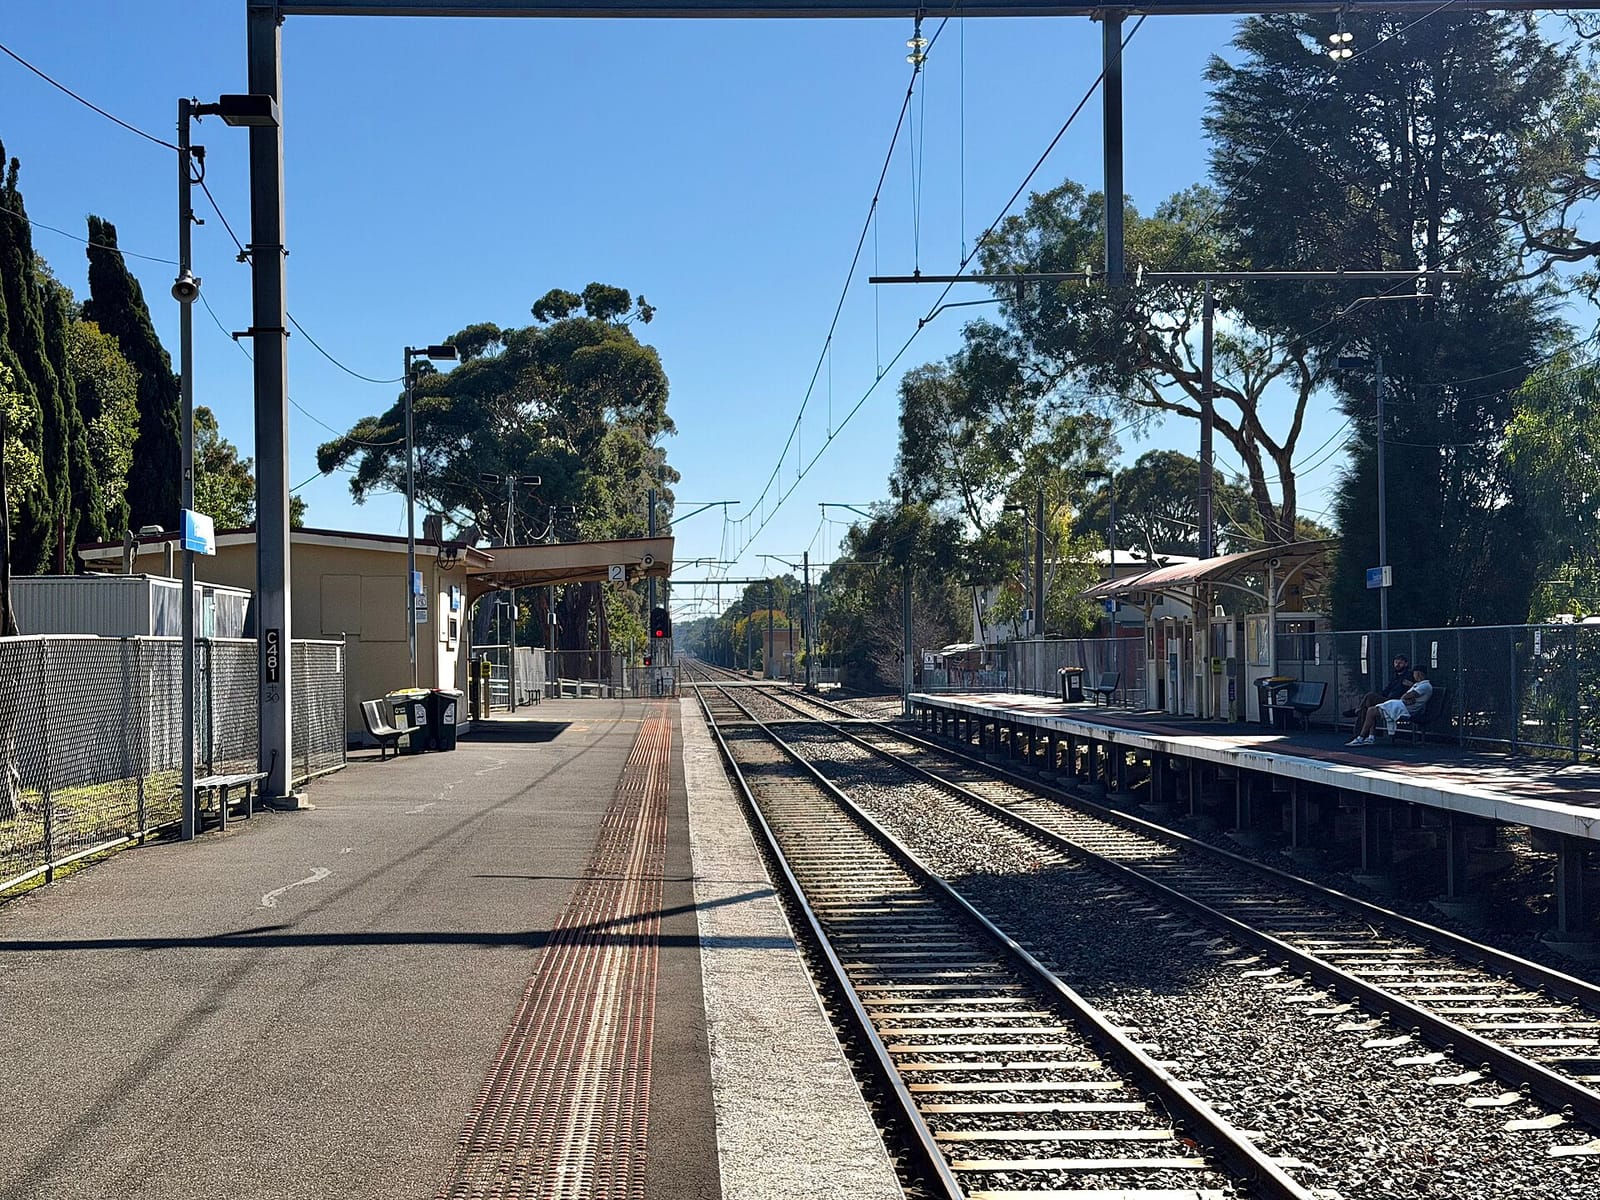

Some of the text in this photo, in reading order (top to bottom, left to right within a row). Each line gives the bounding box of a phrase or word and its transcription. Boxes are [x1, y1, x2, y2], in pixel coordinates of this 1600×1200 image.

[612, 566, 622, 580] 2
[617, 581, 625, 592] 2
[267, 632, 278, 680] C481
